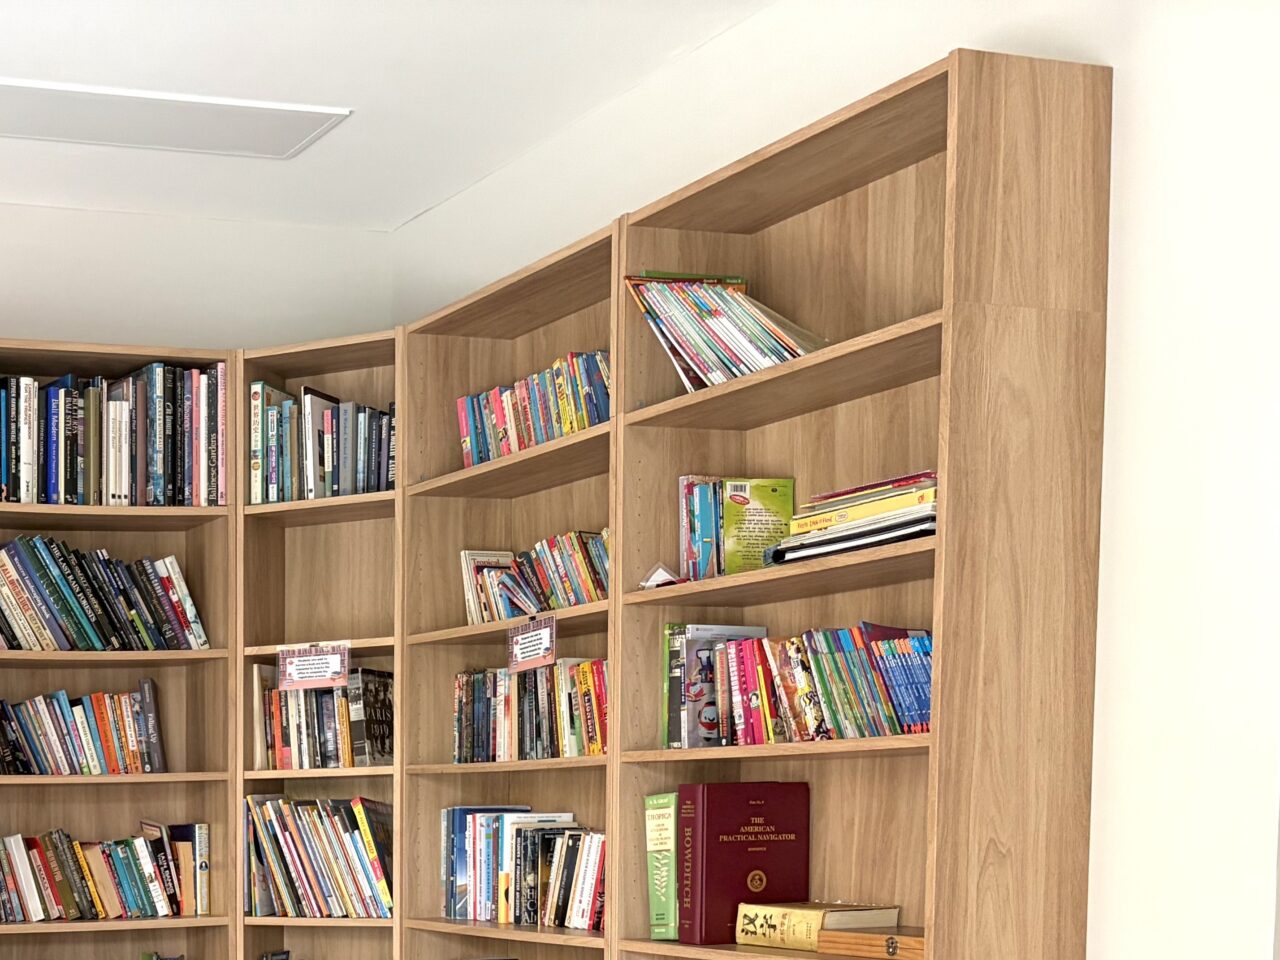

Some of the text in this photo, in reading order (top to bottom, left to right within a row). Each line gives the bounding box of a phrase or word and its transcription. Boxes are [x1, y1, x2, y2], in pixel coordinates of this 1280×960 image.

[51, 399, 59, 414] Bali
[208, 433, 217, 500] Balinese Gardens
[12, 556, 51, 619] Western Landscaping Book
[49, 542, 97, 623] THE LAST RAIN FORESTS
[67, 554, 103, 616] The SMALL GARDEN
[141, 557, 154, 573] JOHN
[366, 707, 392, 722] PARIS
[583, 695, 594, 737] LIONBOY
[158, 851, 168, 869] IAIN
[683, 827, 691, 908] BOWDITCH
